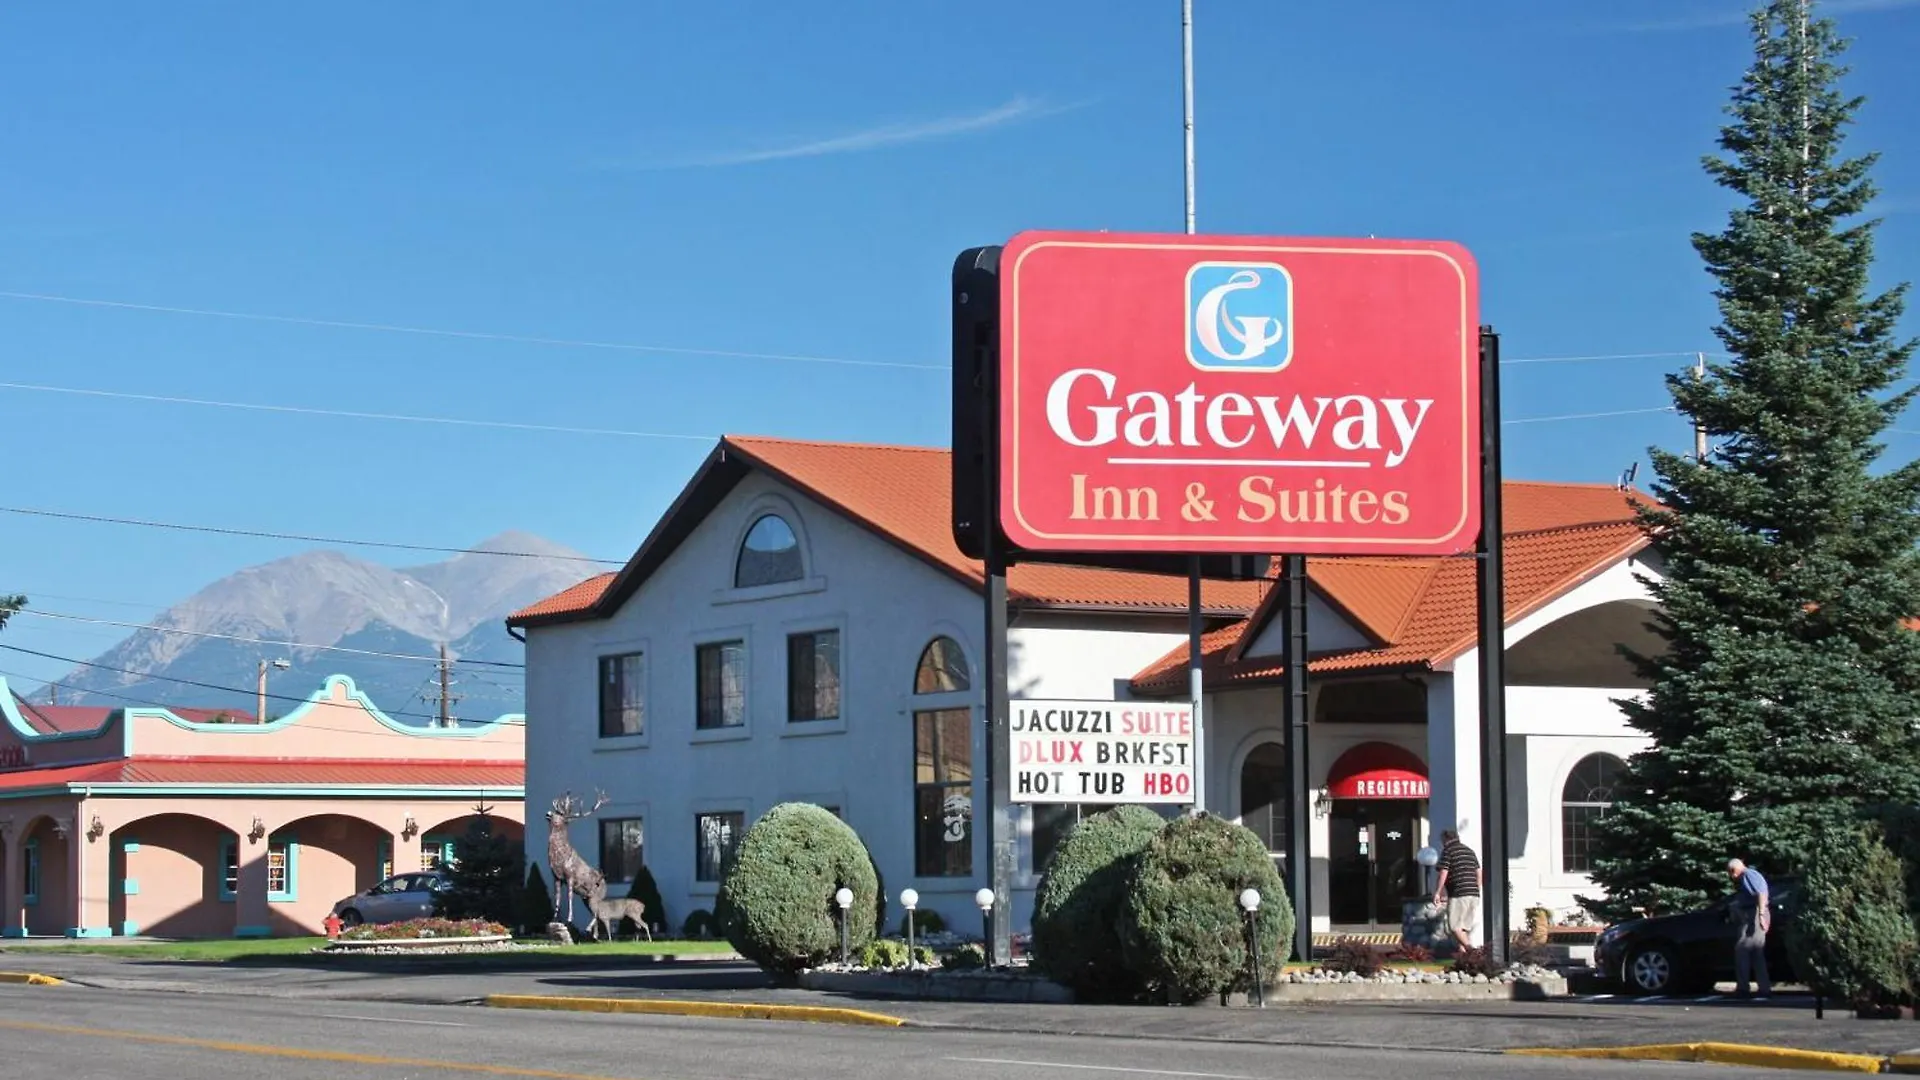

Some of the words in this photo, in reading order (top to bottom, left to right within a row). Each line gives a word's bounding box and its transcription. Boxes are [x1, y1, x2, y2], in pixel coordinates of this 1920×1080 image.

[1046, 368, 1434, 468] Gateway
[1069, 474, 1160, 521] Inn
[1180, 482, 1218, 522] &
[1237, 475, 1410, 525] Suites
[1012, 709, 1112, 733] JACUZZI
[1121, 711, 1191, 734] SUITE
[1019, 741, 1084, 764] DLUX
[1096, 742, 1189, 765] BRKFST
[1018, 771, 1064, 794] HOT
[1078, 772, 1125, 794] TUB
[1143, 773, 1190, 795] HBO
